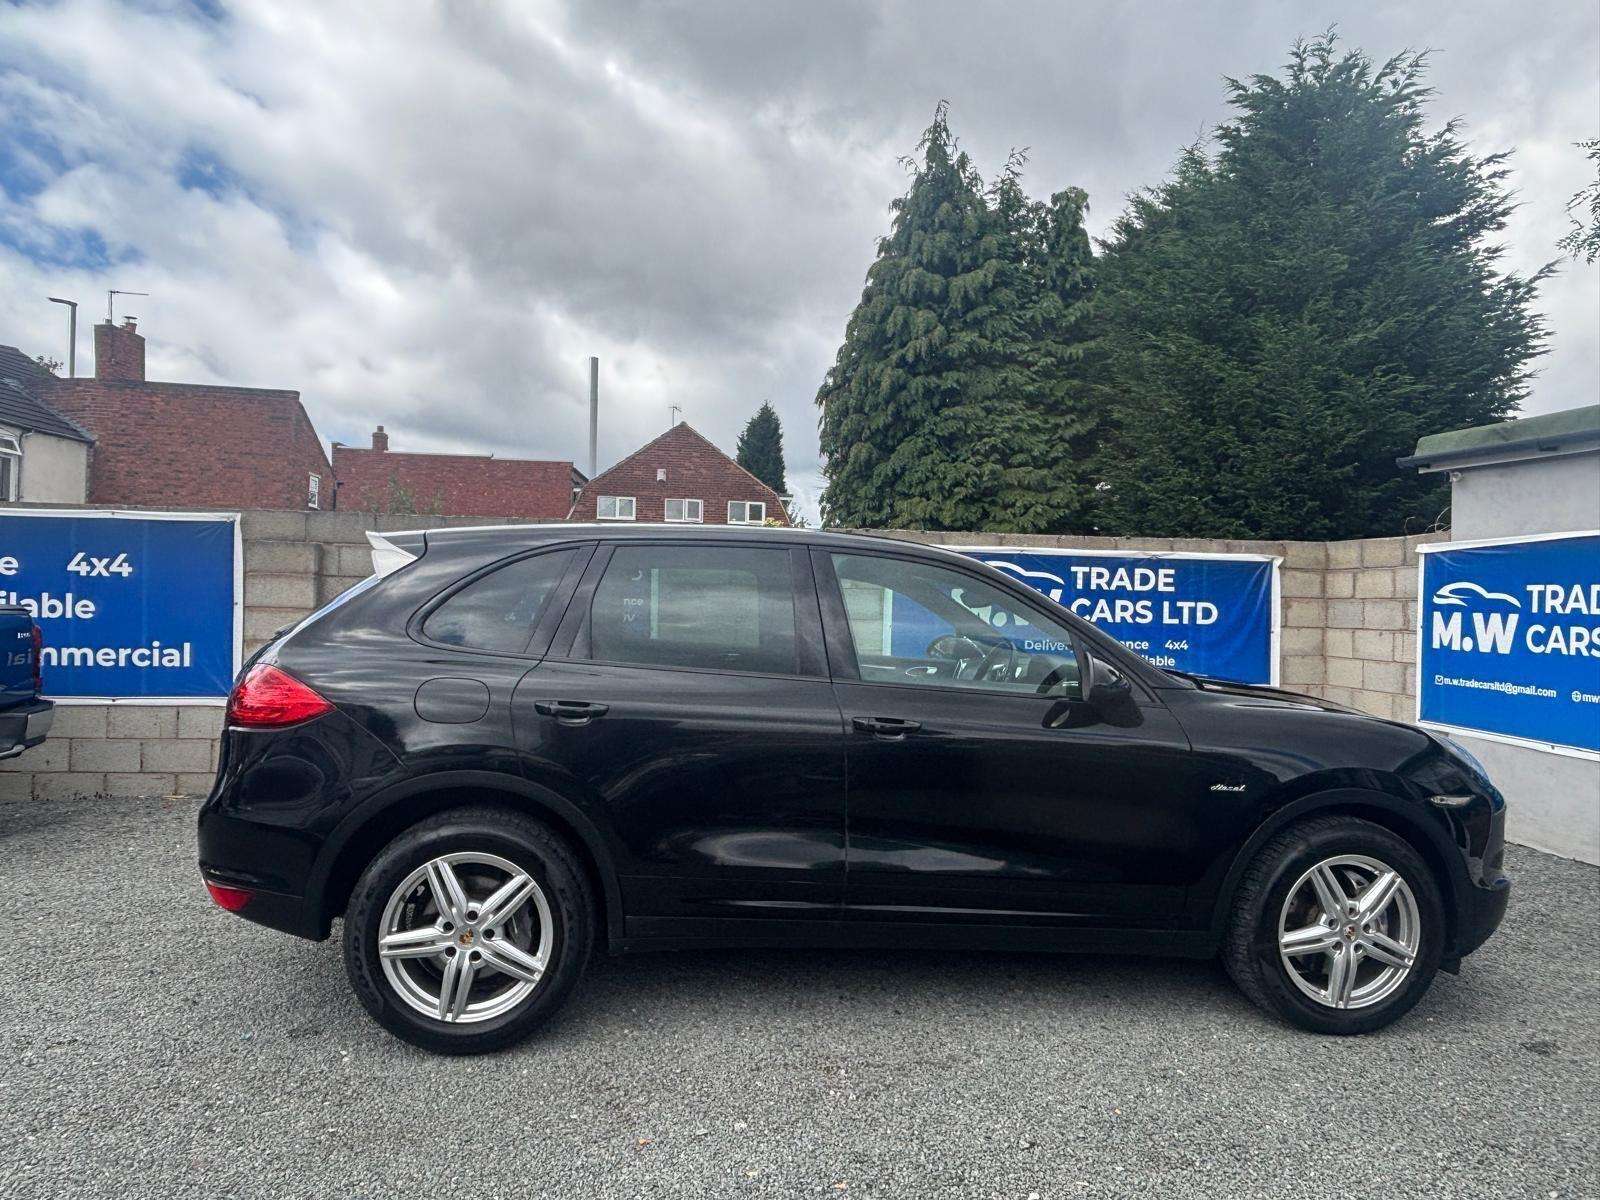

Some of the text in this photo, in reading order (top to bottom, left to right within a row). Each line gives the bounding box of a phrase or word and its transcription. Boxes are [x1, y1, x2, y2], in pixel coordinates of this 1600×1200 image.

[67, 552, 133, 577] 4x4
[1070, 566, 1175, 592] TRADE
[1070, 598, 1152, 624] CARS
[1162, 601, 1219, 625] LTD
[1024, 639, 1069, 651] Delive
[1164, 640, 1189, 650] 4x4
[1432, 611, 1519, 655] M.W
[1525, 624, 1600, 658] CARS
